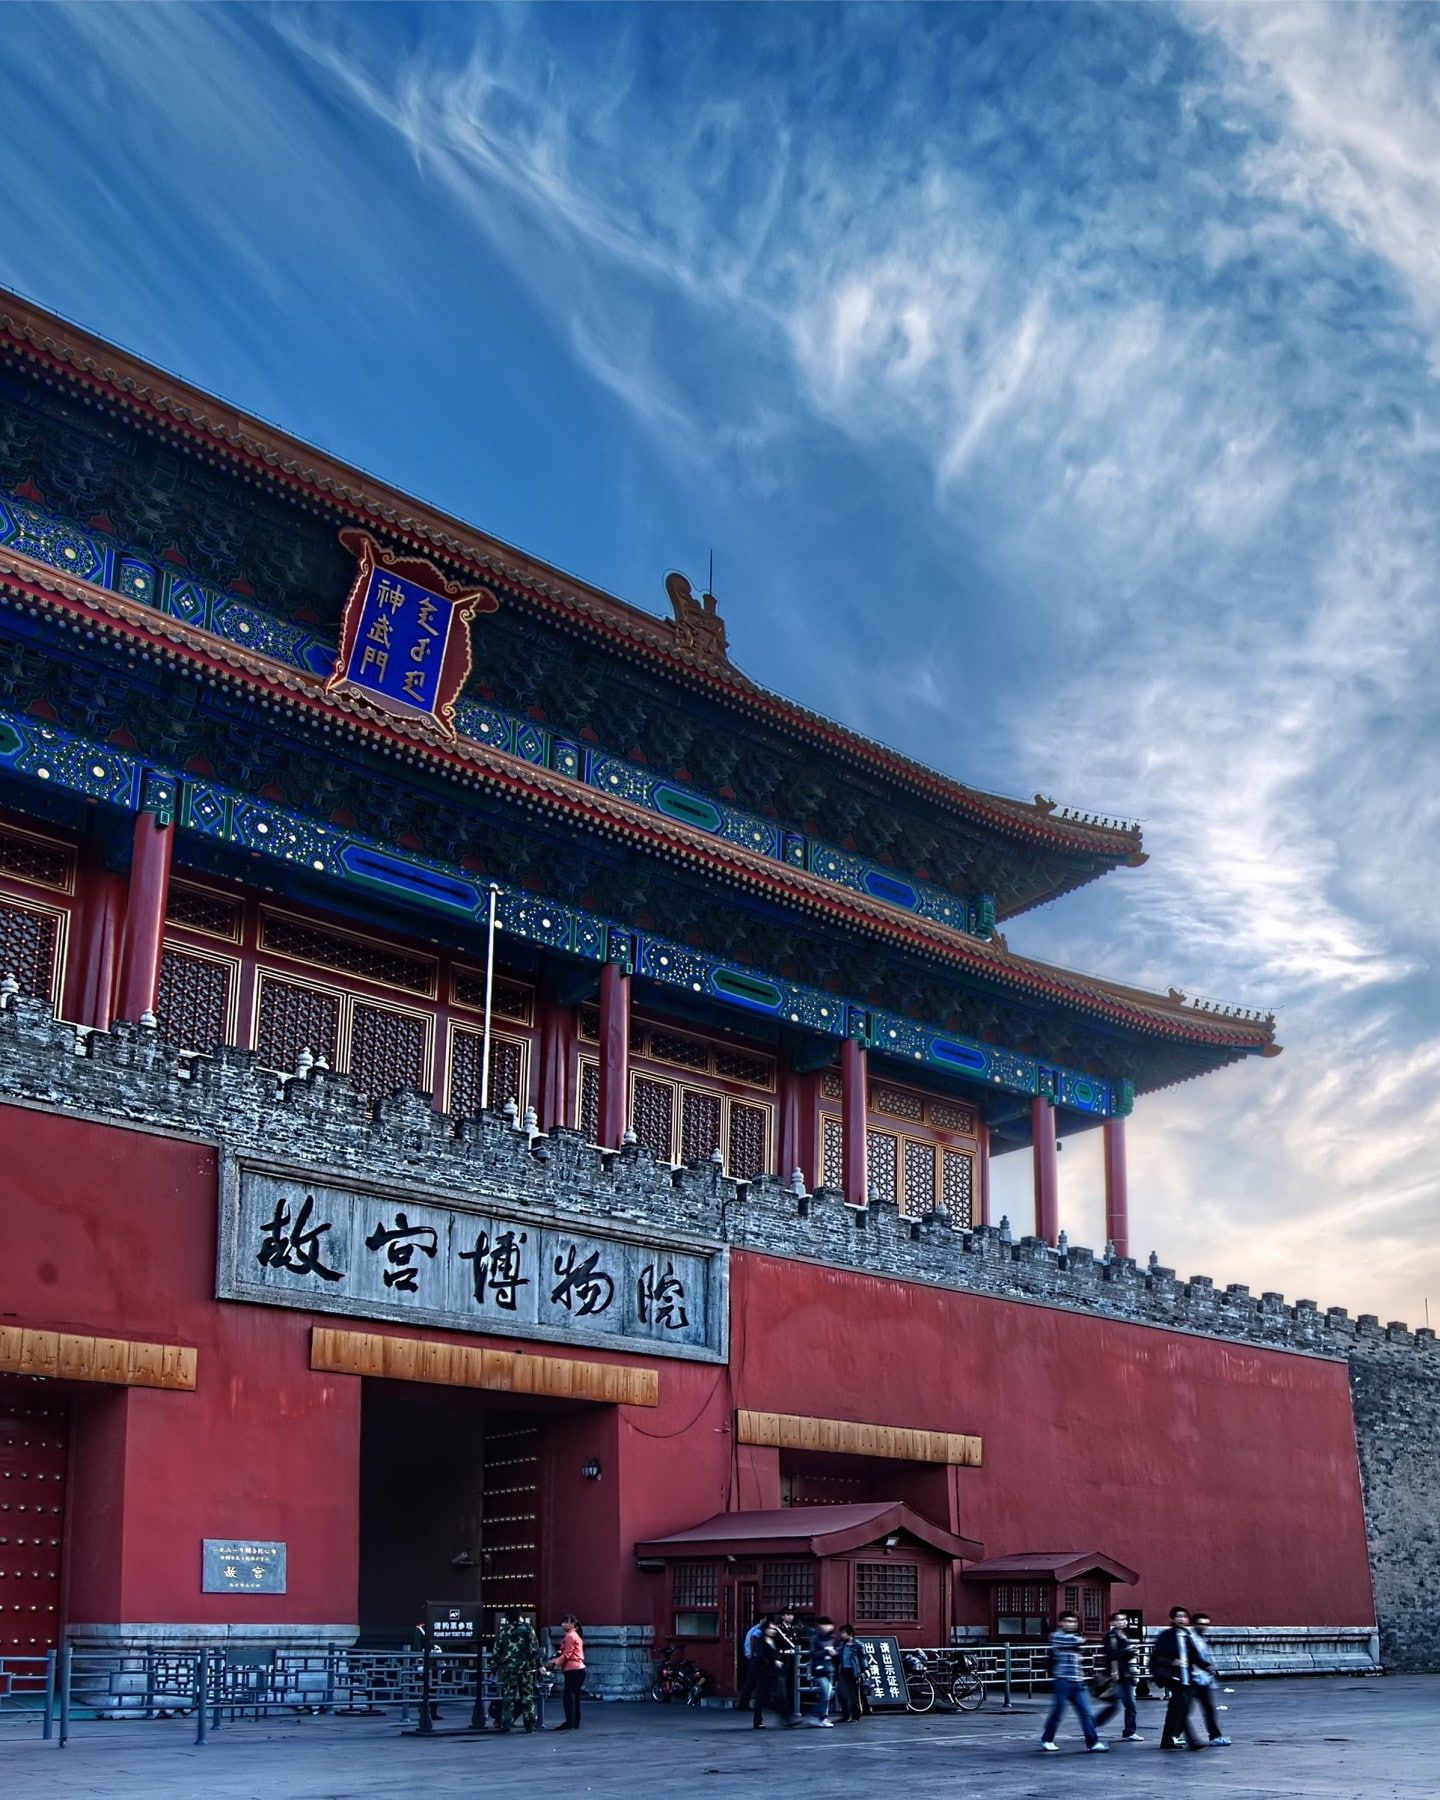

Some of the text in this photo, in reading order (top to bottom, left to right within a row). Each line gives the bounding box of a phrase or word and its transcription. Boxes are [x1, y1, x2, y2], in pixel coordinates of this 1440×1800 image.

[361, 578, 405, 684] 神武門
[865, 1642, 885, 1698] 出入请下车
[880, 1642, 899, 1697] 请出示证件
